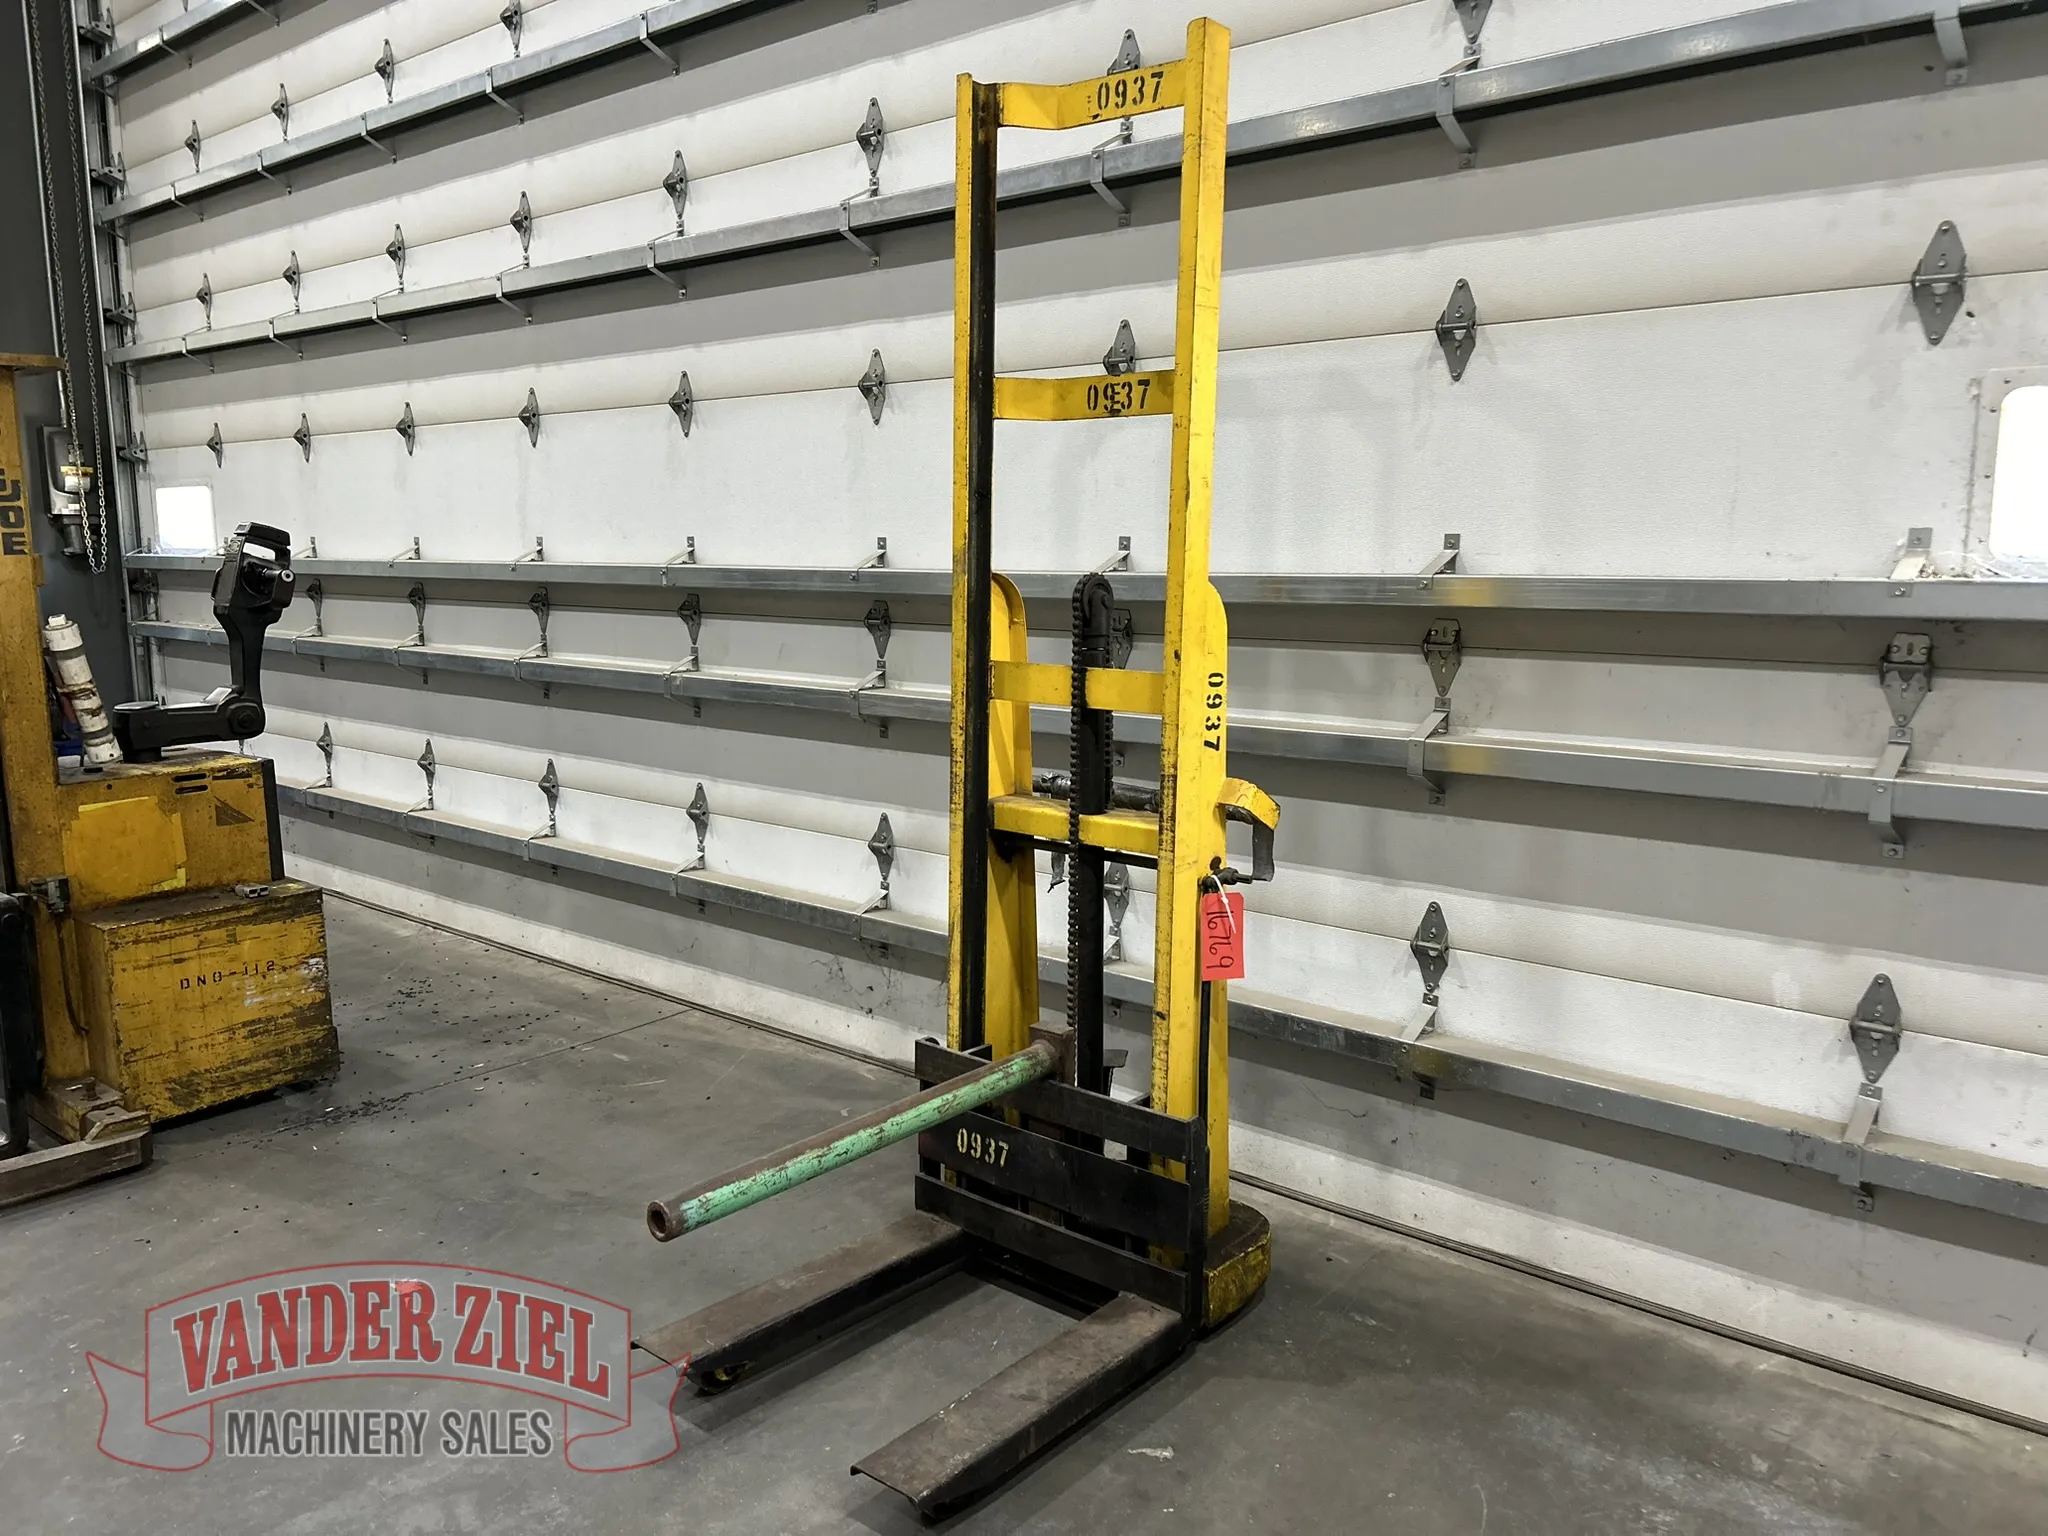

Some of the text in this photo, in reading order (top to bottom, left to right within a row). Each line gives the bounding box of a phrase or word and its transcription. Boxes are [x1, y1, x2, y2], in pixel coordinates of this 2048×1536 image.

[1097, 71, 1164, 111] 0937
[1086, 378, 1151, 412] 0937
[1203, 672, 1224, 752] 0937
[1206, 910, 1235, 970] 16769
[957, 1127, 1009, 1168] 0937
